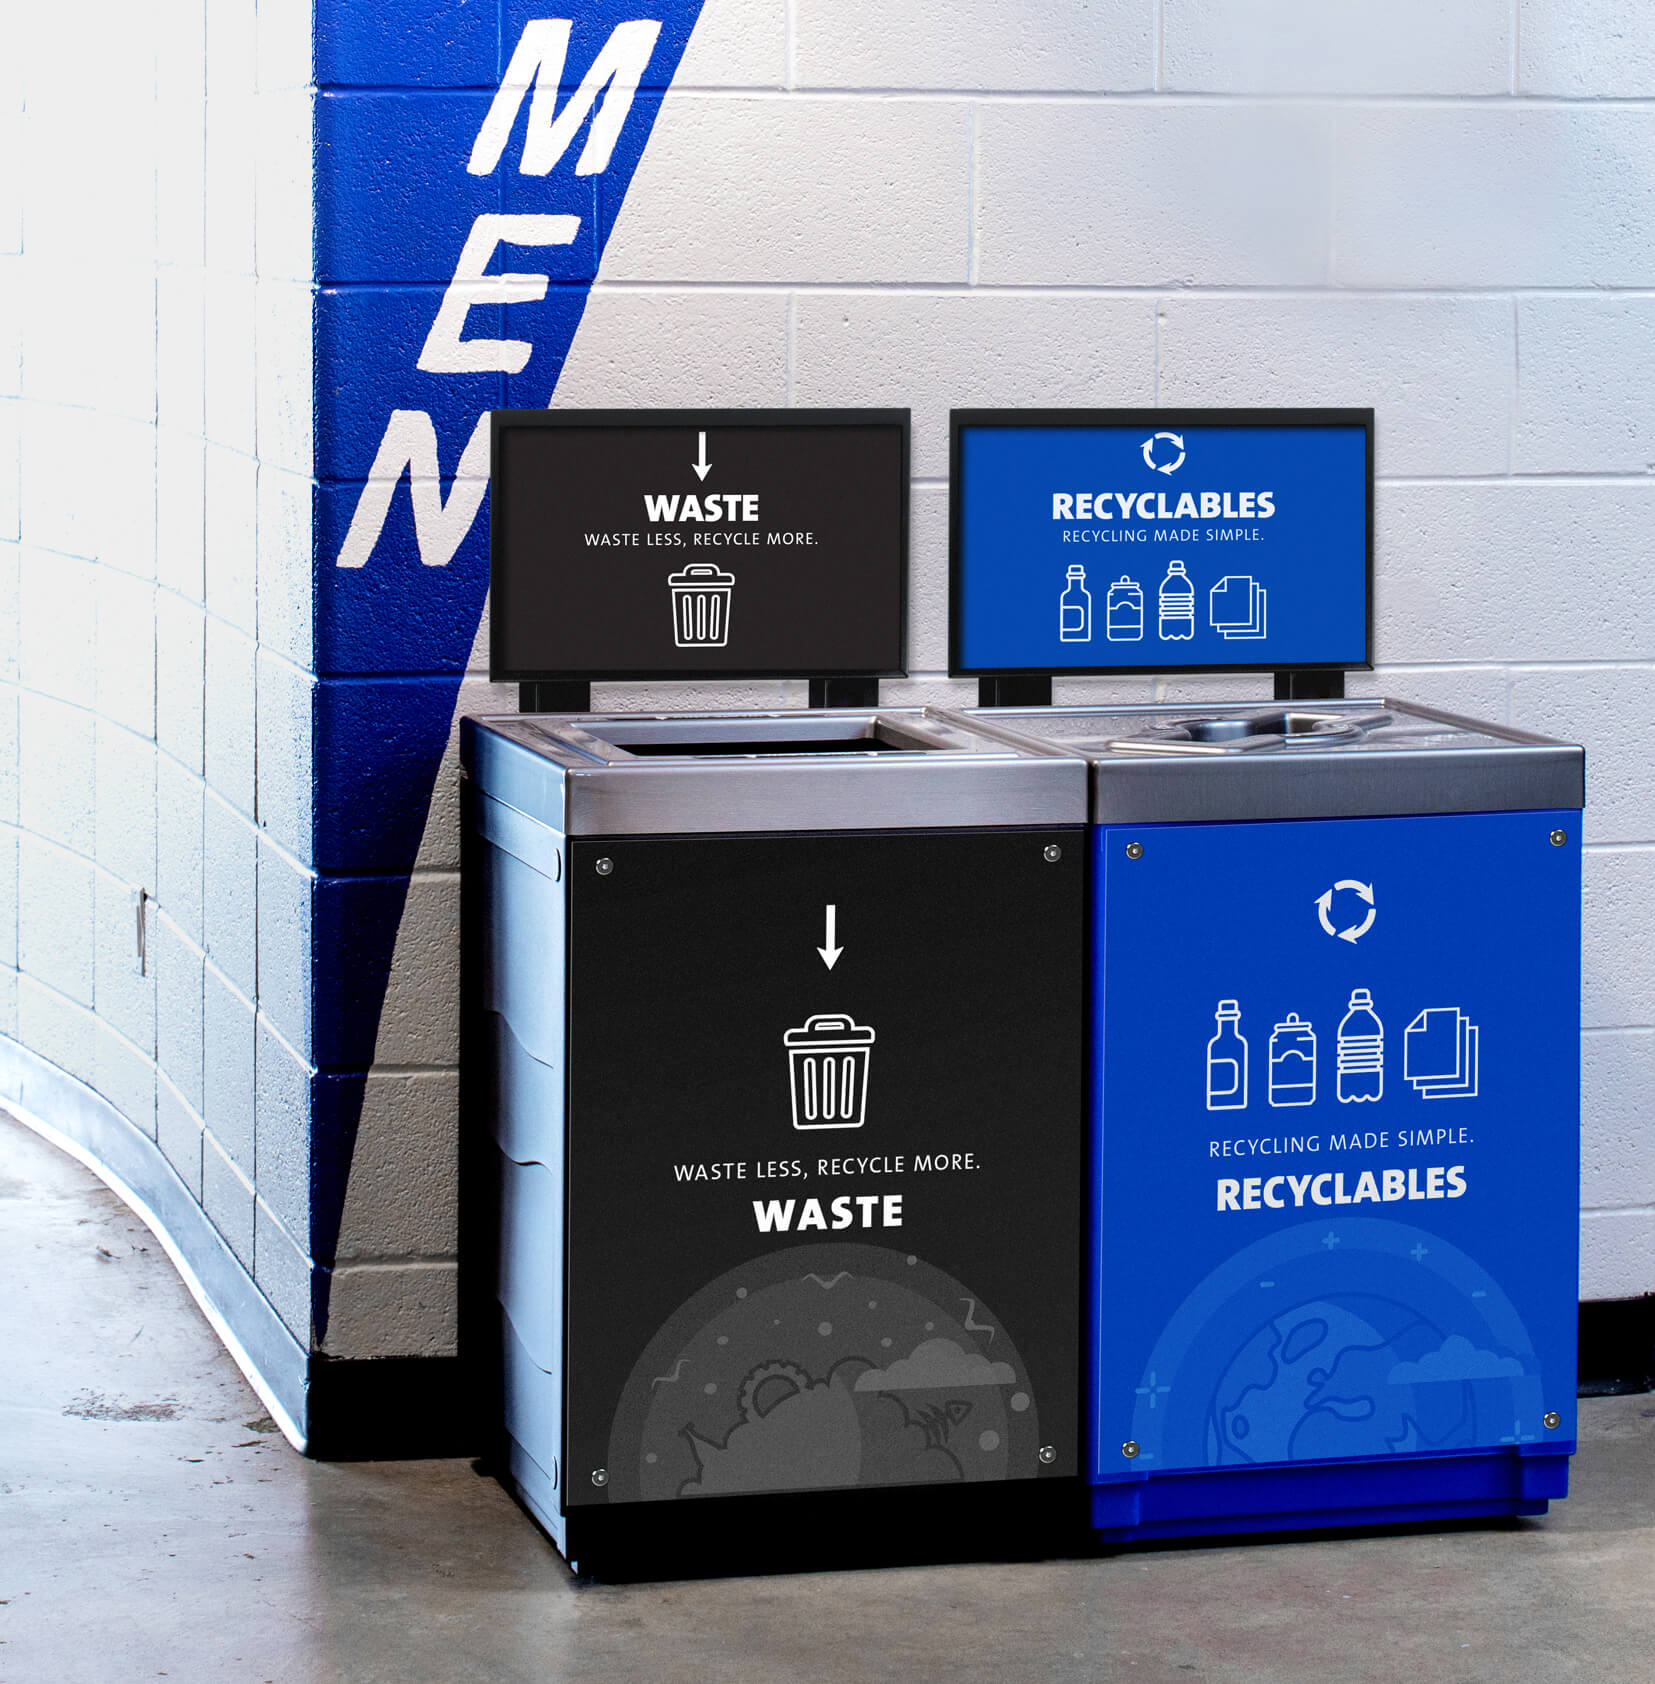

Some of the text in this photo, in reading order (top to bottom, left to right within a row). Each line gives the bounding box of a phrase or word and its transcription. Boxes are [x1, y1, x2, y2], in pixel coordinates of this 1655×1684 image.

[644, 494, 760, 523] WASTE
[1052, 491, 1276, 521] RECYCLABLES
[584, 532, 819, 548] WASTE LESS, RECYCLE MORE.
[1062, 528, 1265, 543] RECYCLING MADE SIMPLE.
[1209, 1127, 1475, 1158] RECYCLING MADE SIMPLE.
[673, 1152, 981, 1182] WASTE LESS, RECYCLE MORE.
[1216, 1165, 1467, 1212] RECYCLABLES
[752, 1194, 903, 1233] WASTE
